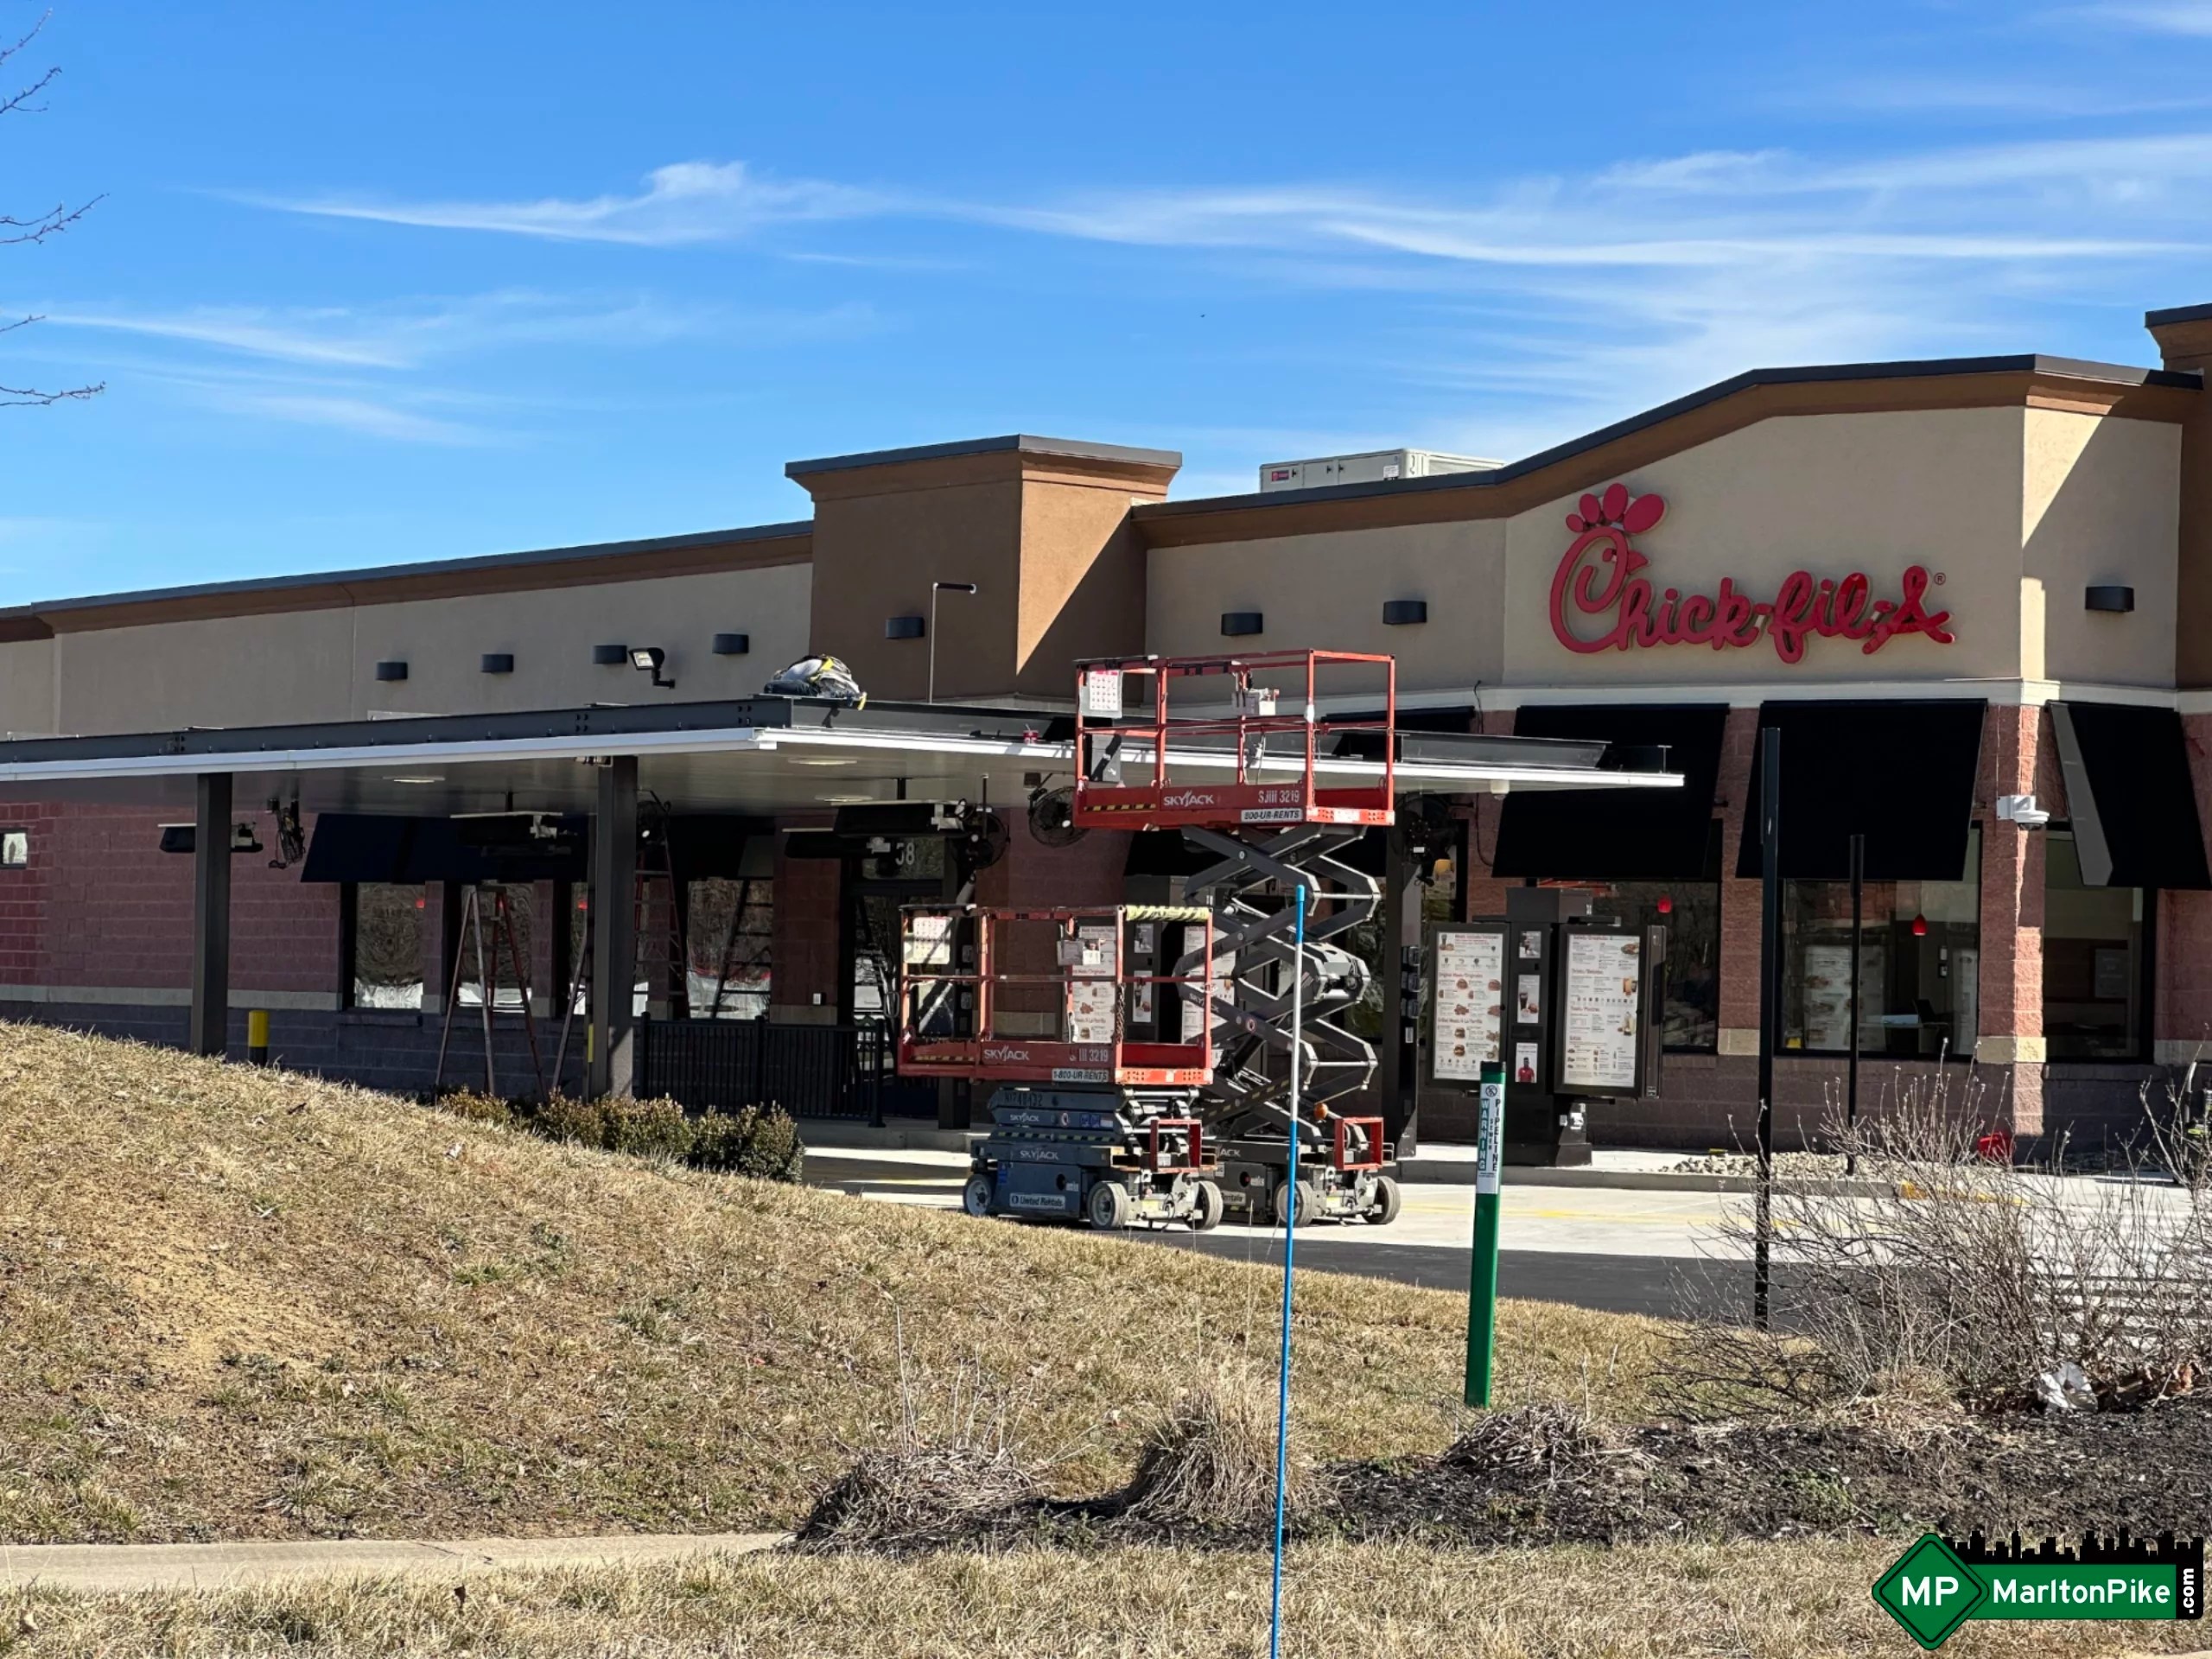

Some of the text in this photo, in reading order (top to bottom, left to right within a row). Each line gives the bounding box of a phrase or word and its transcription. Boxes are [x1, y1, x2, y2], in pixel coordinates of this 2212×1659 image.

[1550, 518, 1955, 664] Chick-fil-A
[1164, 790, 1214, 806] SKYJACK
[1279, 790, 1300, 803] 3219
[984, 1046, 1030, 1061] SKYJACK
[1089, 1048, 1109, 1062] 3219
[1478, 1099, 1489, 1170] WARNING
